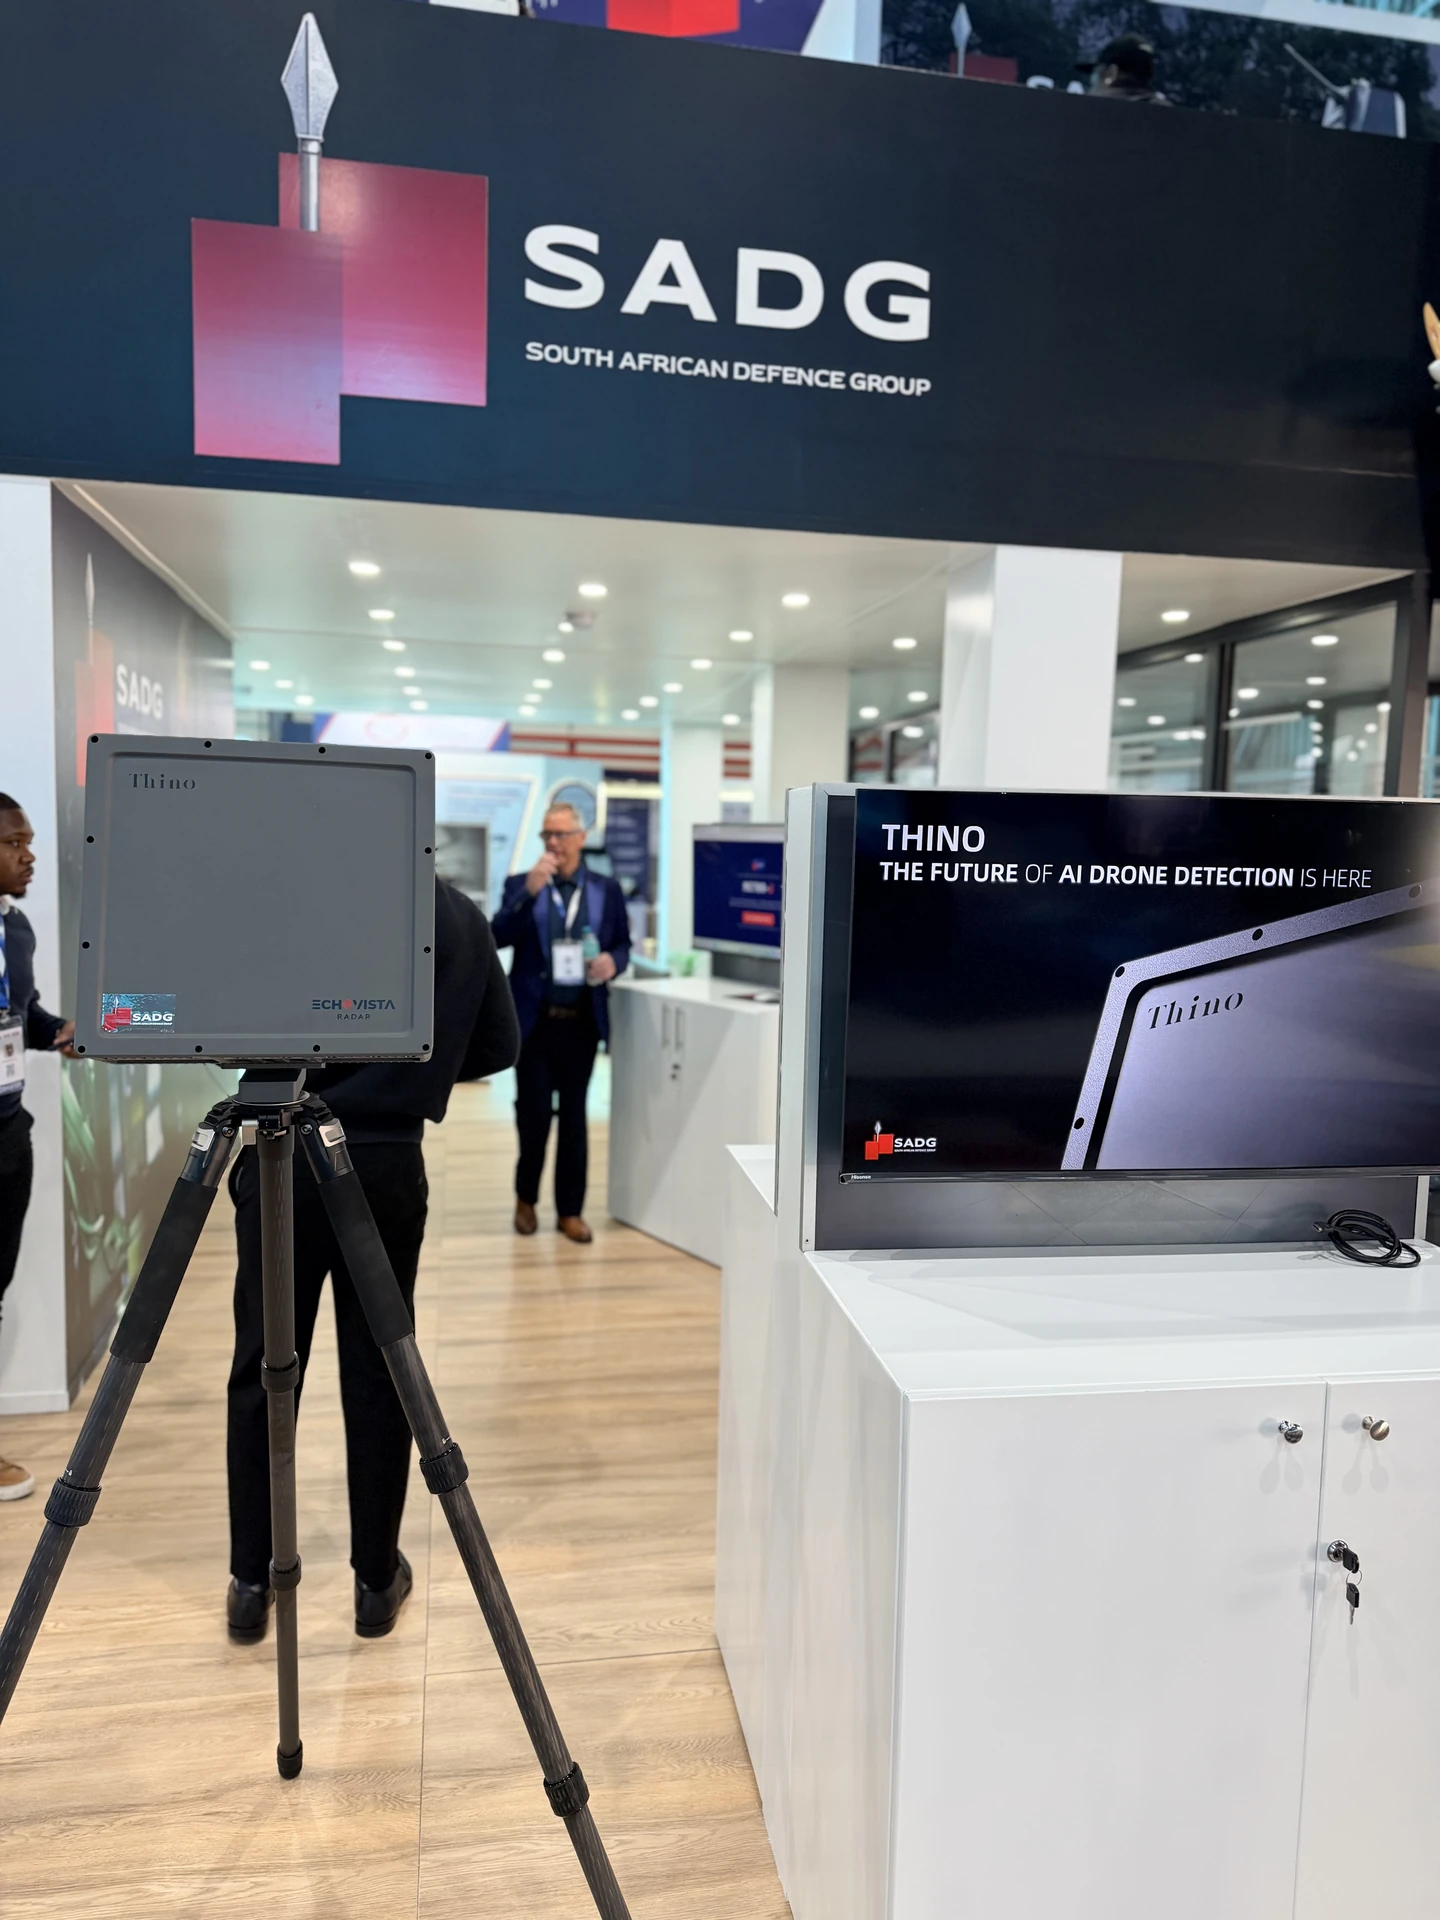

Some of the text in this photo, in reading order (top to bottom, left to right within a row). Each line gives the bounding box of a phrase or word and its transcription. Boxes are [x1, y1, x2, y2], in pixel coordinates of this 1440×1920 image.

[524, 224, 930, 342] SADG
[525, 341, 931, 397] SOUTH AFRICAN DEFENCE GROUP
[116, 663, 164, 720] SADG
[129, 773, 196, 790] Thino
[882, 824, 986, 853] THINO
[879, 861, 1372, 888] THE FUTURE OF AI DRONE DETECTION IS HERE
[132, 1013, 173, 1022] SADG
[1148, 992, 1244, 1029] Thino
[894, 1137, 937, 1148] SADG
